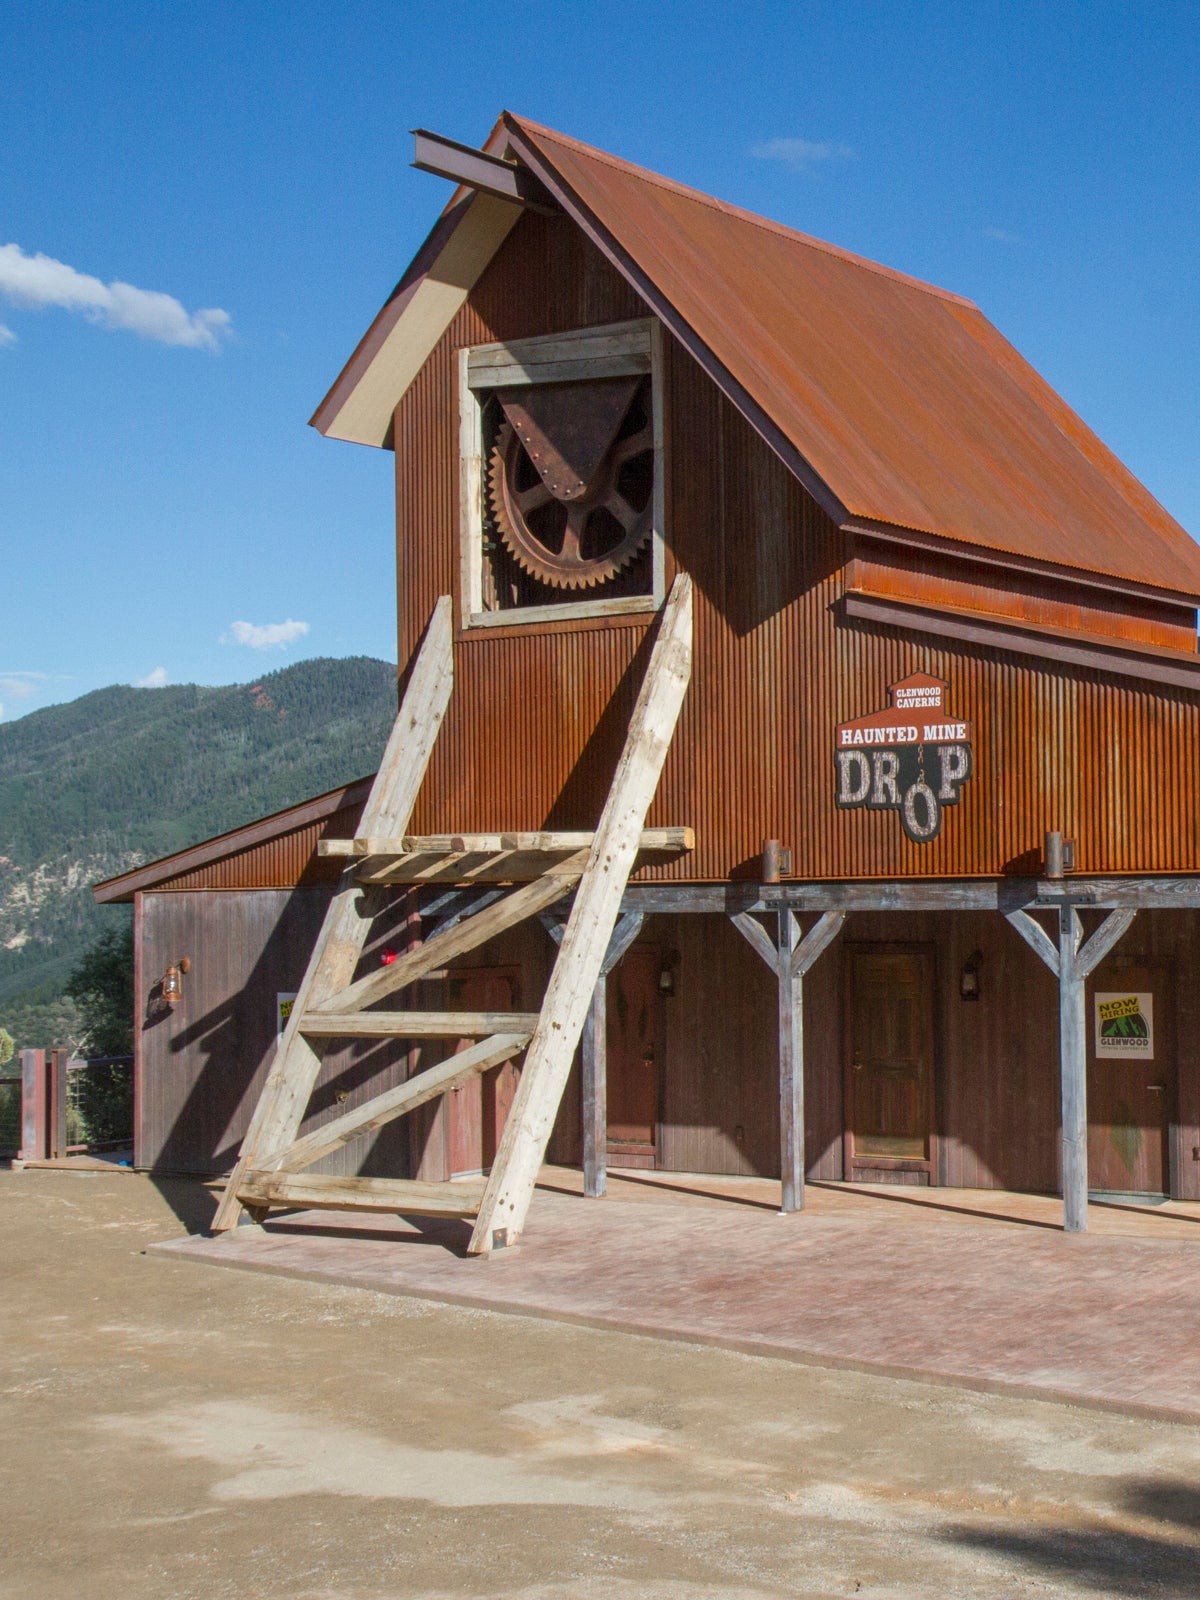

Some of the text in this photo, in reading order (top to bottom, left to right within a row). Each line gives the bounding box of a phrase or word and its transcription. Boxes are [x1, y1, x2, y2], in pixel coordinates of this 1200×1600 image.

[896, 686, 941, 697] GLENWOOD
[896, 696, 941, 709] CAVERNS
[841, 723, 966, 745] HAUNTED MINE
[837, 745, 969, 837] DROP
[1100, 998, 1137, 1011] NOW
[1101, 1005, 1139, 1019] HIRING
[1101, 1038, 1149, 1046] GLENWOOD
